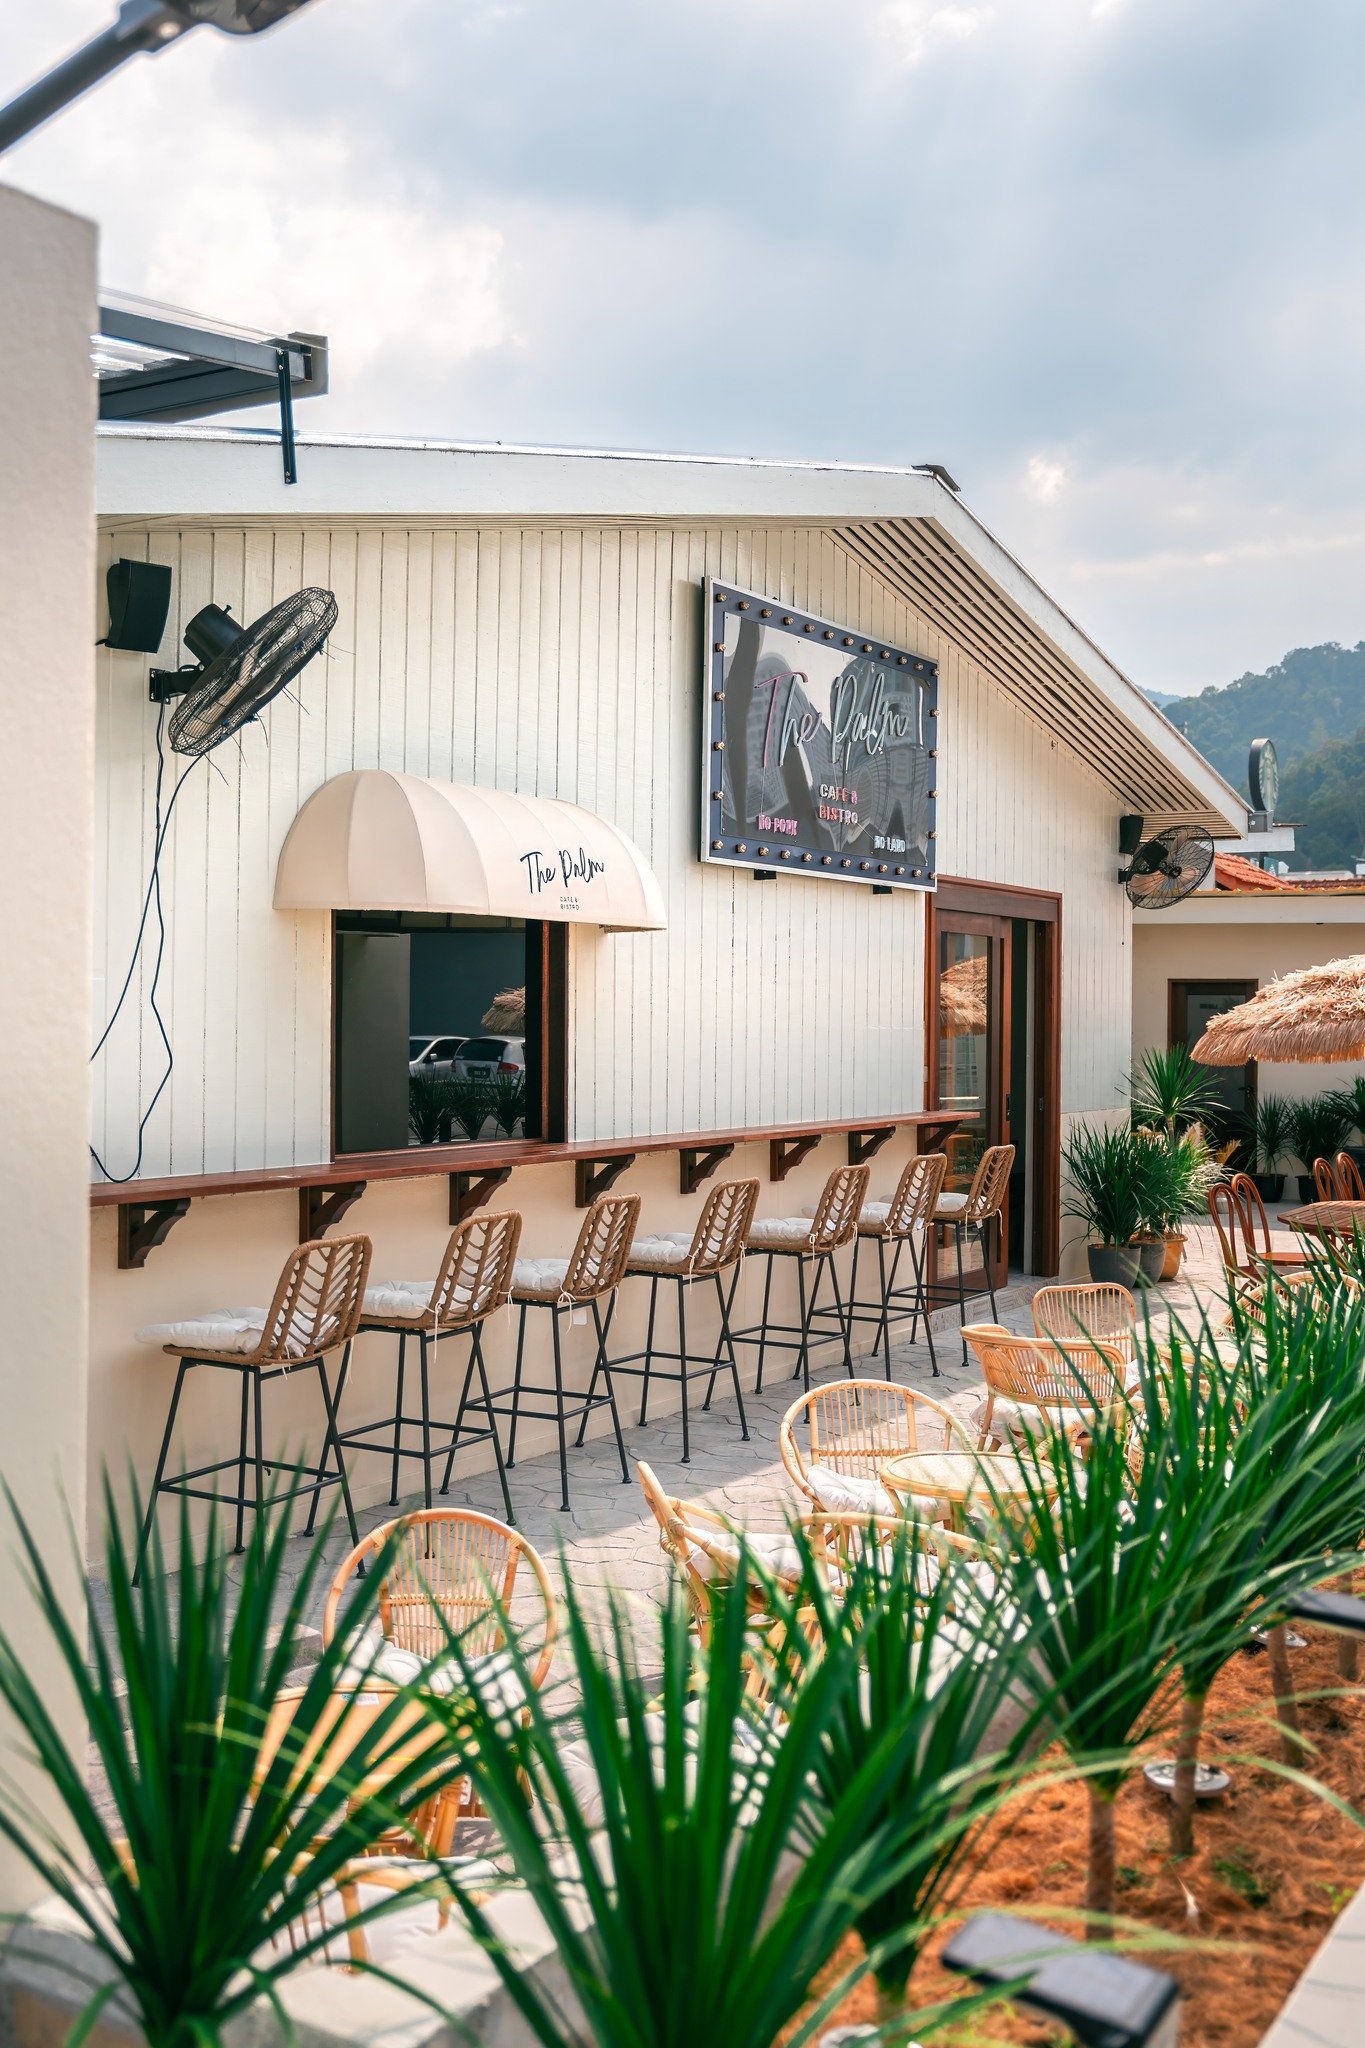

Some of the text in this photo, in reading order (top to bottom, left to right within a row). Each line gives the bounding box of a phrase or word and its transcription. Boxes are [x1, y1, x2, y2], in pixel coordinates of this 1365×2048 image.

[754, 671, 909, 768] The Palm
[758, 814, 772, 831] NO
[819, 804, 859, 825] BISTRO
[874, 835, 886, 850] NO
[519, 847, 605, 894] The Palm
